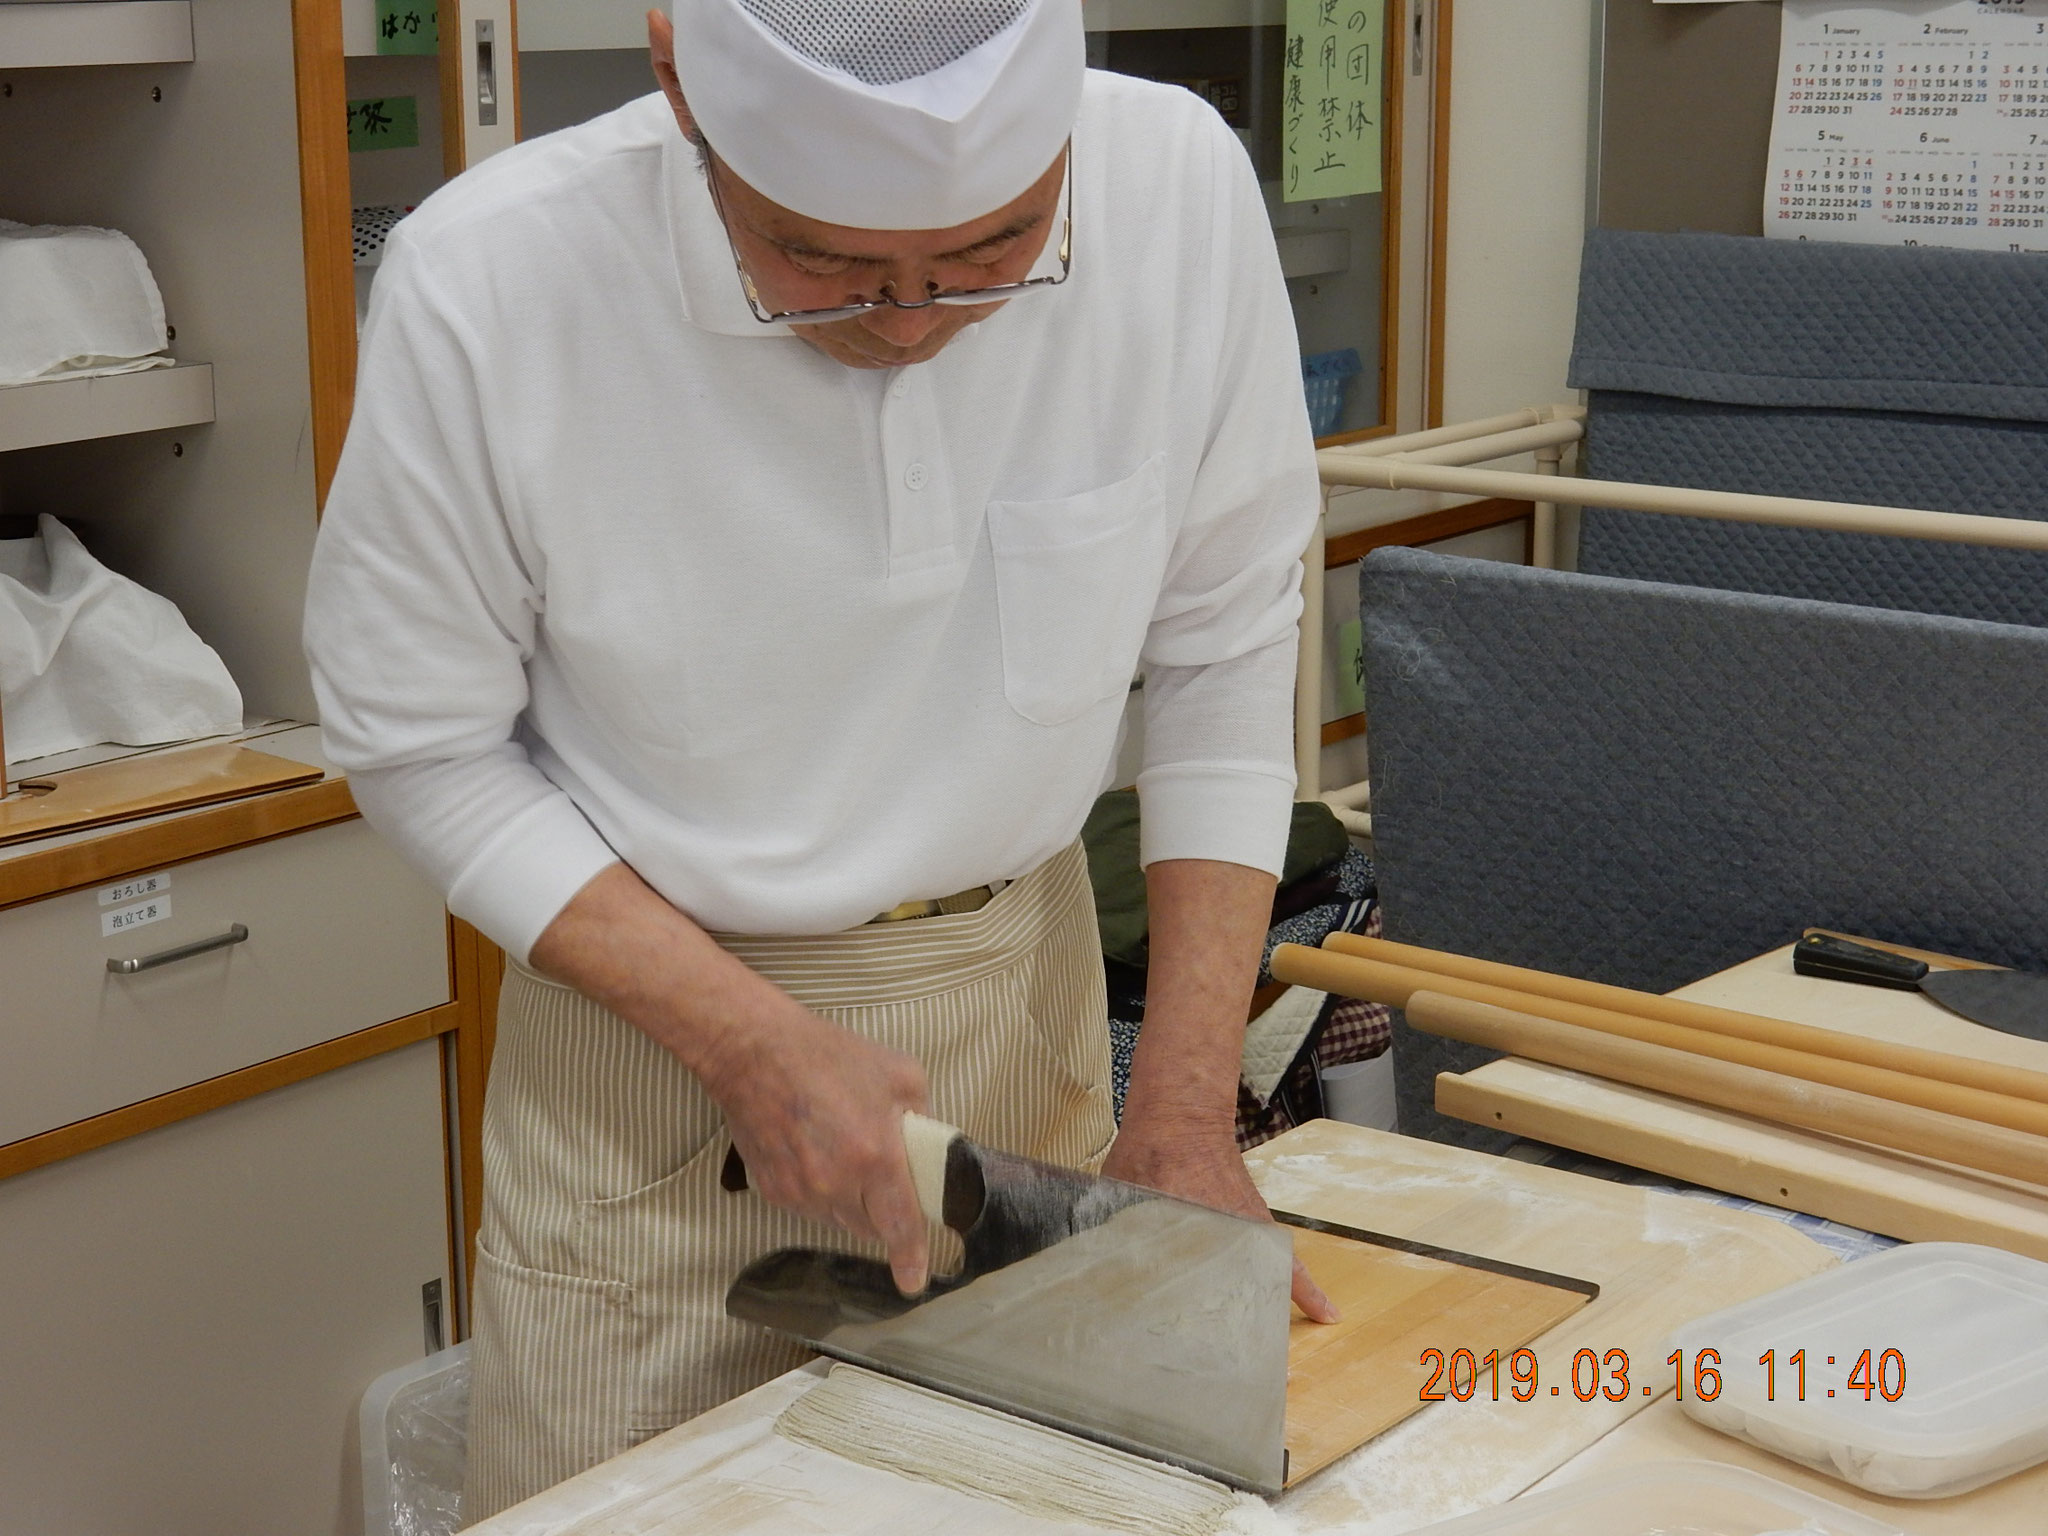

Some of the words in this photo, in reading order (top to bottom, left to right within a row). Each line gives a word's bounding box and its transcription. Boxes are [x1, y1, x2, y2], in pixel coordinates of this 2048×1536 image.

[1935, 27, 1969, 35] February
[1846, 64, 1858, 73] 10
[1861, 64, 1870, 73] 11
[1874, 64, 1884, 73] 12
[1347, 11, 1373, 141] の団体
[1792, 77, 1802, 86] 13
[1805, 78, 1815, 86] 14
[1818, 78, 1828, 87] 15
[1832, 78, 1841, 86] 16
[1845, 78, 1855, 87] 17
[1859, 78, 1869, 87] 18
[1872, 78, 1883, 87] 19
[1921, 79, 1932, 88] 12
[1935, 79, 1946, 88] 13
[1949, 79, 1959, 87] 14
[1963, 79, 1973, 88] 15
[1977, 79, 1988, 88] 16
[2028, 80, 2039, 89] 12
[1789, 91, 1802, 100] 20
[1804, 92, 1814, 100] 21
[1816, 91, 1828, 100] 22
[1829, 92, 1841, 100] 23
[1842, 92, 1855, 101] 24
[1856, 92, 1868, 101] 25
[1870, 92, 1882, 101] 26
[1907, 93, 1917, 101] 18
[1920, 93, 1931, 102] 19
[1933, 93, 1946, 102] 20
[1948, 93, 1959, 102] 21
[1961, 93, 1973, 102] 22
[1974, 94, 1987, 103] 23
[2013, 94, 2023, 103] 18
[2027, 94, 2038, 103] 19
[1286, 34, 1304, 193] 健康づくり
[1801, 105, 1813, 114] 28
[1814, 105, 1827, 114] 29
[1828, 106, 1840, 114] 30
[1842, 106, 1853, 114] 31
[1890, 107, 1903, 115] 24
[1904, 107, 1916, 116] 25
[1918, 107, 1930, 116] 26
[1932, 107, 1944, 116] 27
[1945, 107, 1958, 116] 28
[2010, 108, 2023, 117] 25
[2024, 108, 2037, 117] 26
[1829, 134, 1844, 142] May
[1849, 171, 1860, 180] 10
[1864, 172, 1873, 180] 11
[2034, 176, 2046, 185] 10
[1794, 183, 1804, 192] 13
[1807, 184, 1817, 192] 14
[1821, 184, 1831, 193] 15
[1834, 185, 1845, 193] 16
[1849, 185, 1858, 194] 17
[1862, 186, 1872, 194] 18
[1897, 186, 1908, 195] 10
[1912, 187, 1921, 196] 11
[1925, 187, 1935, 196] 12
[1939, 188, 1949, 197] 13
[1953, 188, 1963, 196] 14
[1990, 190, 2000, 198] 14
[2019, 190, 2030, 199] 16
[2034, 191, 2045, 199] 17
[1779, 197, 1790, 205] 19
[1792, 197, 1804, 206] 20
[1807, 198, 1817, 206] 21
[1819, 198, 1831, 207] 22
[1833, 198, 1845, 207] 23
[1846, 199, 1858, 208] 24
[1860, 199, 1872, 208] 25
[1882, 200, 1893, 209] 16
[1897, 201, 1907, 209] 17
[1910, 201, 1920, 210] 18
[1924, 201, 1934, 210] 19
[1937, 202, 1950, 211] 20
[1952, 202, 1963, 211] 21
[1966, 203, 1978, 212] 22
[2003, 204, 2016, 213] 22
[2017, 204, 2030, 213] 23
[2032, 205, 2045, 214] 24
[1778, 210, 1790, 219] 26
[1792, 211, 1803, 219] 27
[1805, 211, 1817, 220] 28
[1818, 212, 1831, 220] 29
[1832, 212, 1845, 221] 30
[1848, 213, 1857, 221] 31
[1895, 214, 1907, 223] 24
[1909, 215, 1921, 224] 25
[1923, 215, 1936, 224] 26
[1937, 216, 1949, 225] 27
[1951, 216, 1963, 225] 28
[1965, 217, 1978, 226] 29
[1988, 218, 2001, 227] 28
[2002, 218, 2016, 227] 29
[2017, 218, 2030, 228] 30
[2033, 219, 2044, 228] 31
[112, 878, 157, 900] おろし器
[112, 904, 157, 928] 泡立て器
